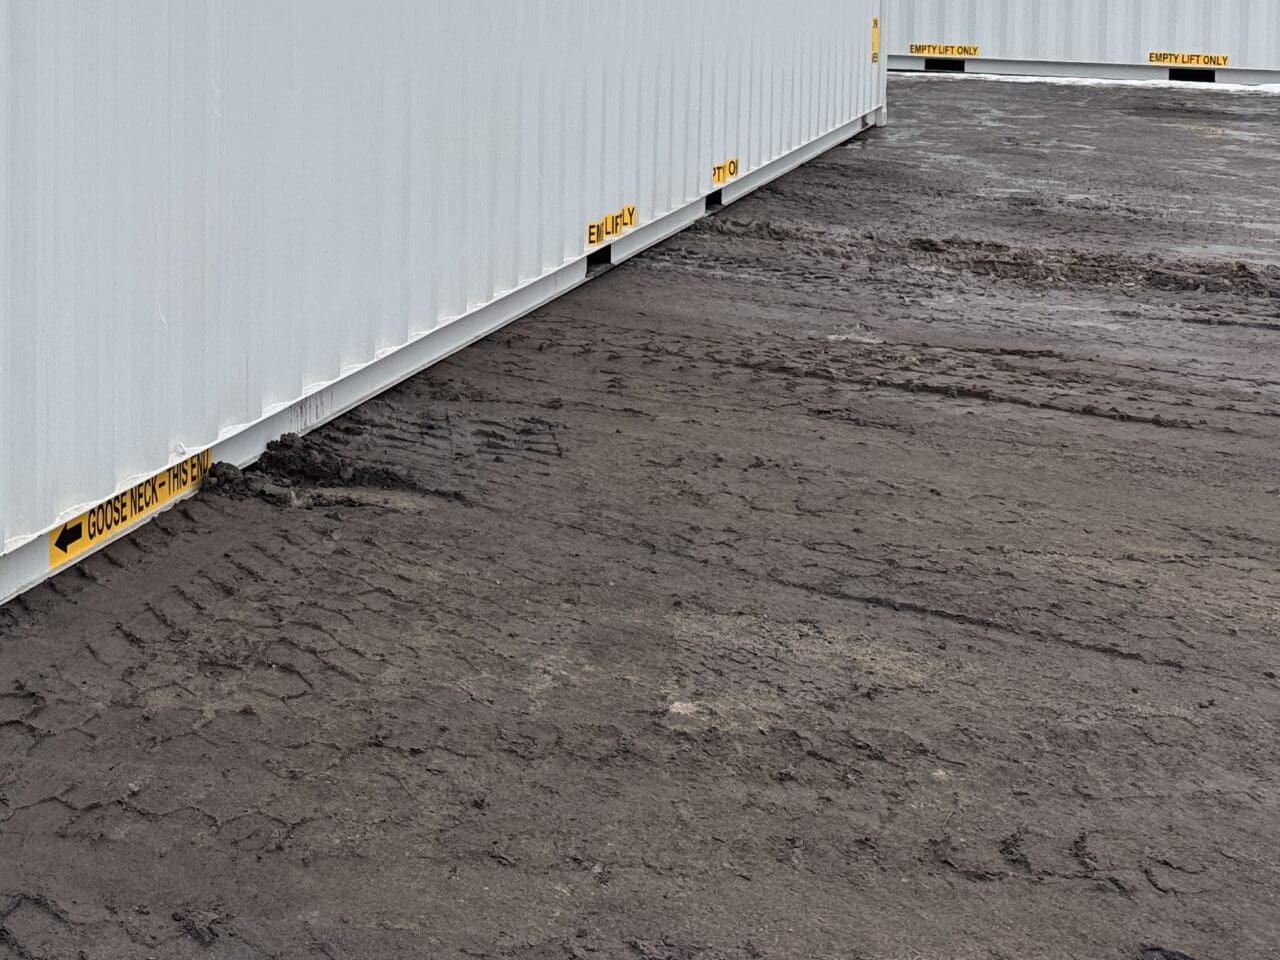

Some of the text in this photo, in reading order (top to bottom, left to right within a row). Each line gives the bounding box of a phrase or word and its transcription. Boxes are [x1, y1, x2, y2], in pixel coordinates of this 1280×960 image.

[910, 44, 979, 56] EMPTY LIFT ONLY
[1149, 52, 1228, 66] EMPTY LIFT ONLY
[87, 491, 127, 541] GOOSE
